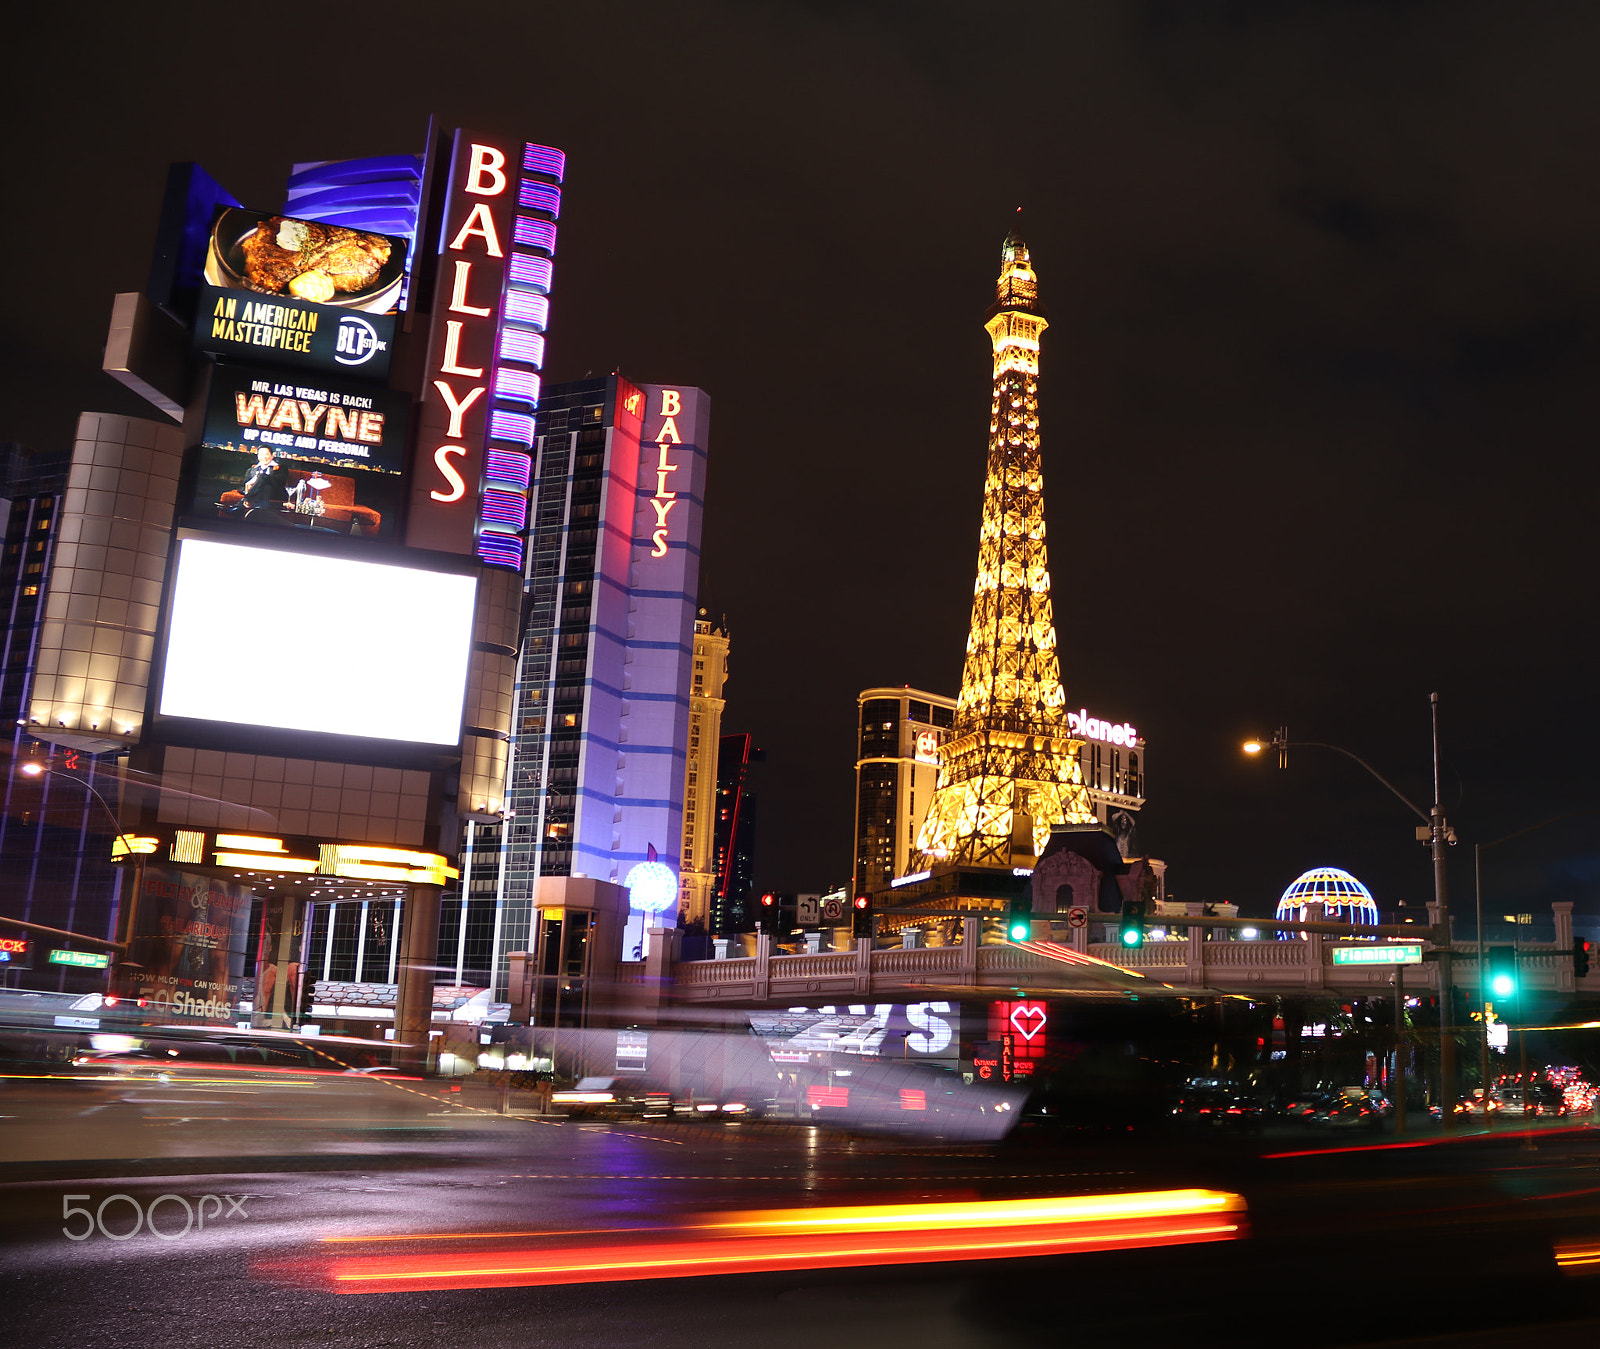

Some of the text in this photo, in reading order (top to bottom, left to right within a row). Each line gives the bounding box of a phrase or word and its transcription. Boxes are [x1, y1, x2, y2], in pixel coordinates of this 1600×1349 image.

[213, 297, 319, 333] AN AMERICAN
[430, 143, 507, 503] BALLYS
[211, 318, 314, 353] MASTERPIECE
[336, 325, 368, 355] BLT
[251, 380, 373, 409] MR. LAS VEGAS IS BACK!
[235, 391, 385, 445] WAYNE
[244, 428, 371, 458] UP CLOSE AND PERSONAL
[649, 389, 683, 558] BALLYS
[1066, 708, 1137, 748] planet
[55, 950, 71, 961] Las
[73, 952, 96, 966] Vegas
[1340, 948, 1404, 962] Flamingo
[194, 980, 207, 989] CAN
[208, 982, 221, 991] YOU
